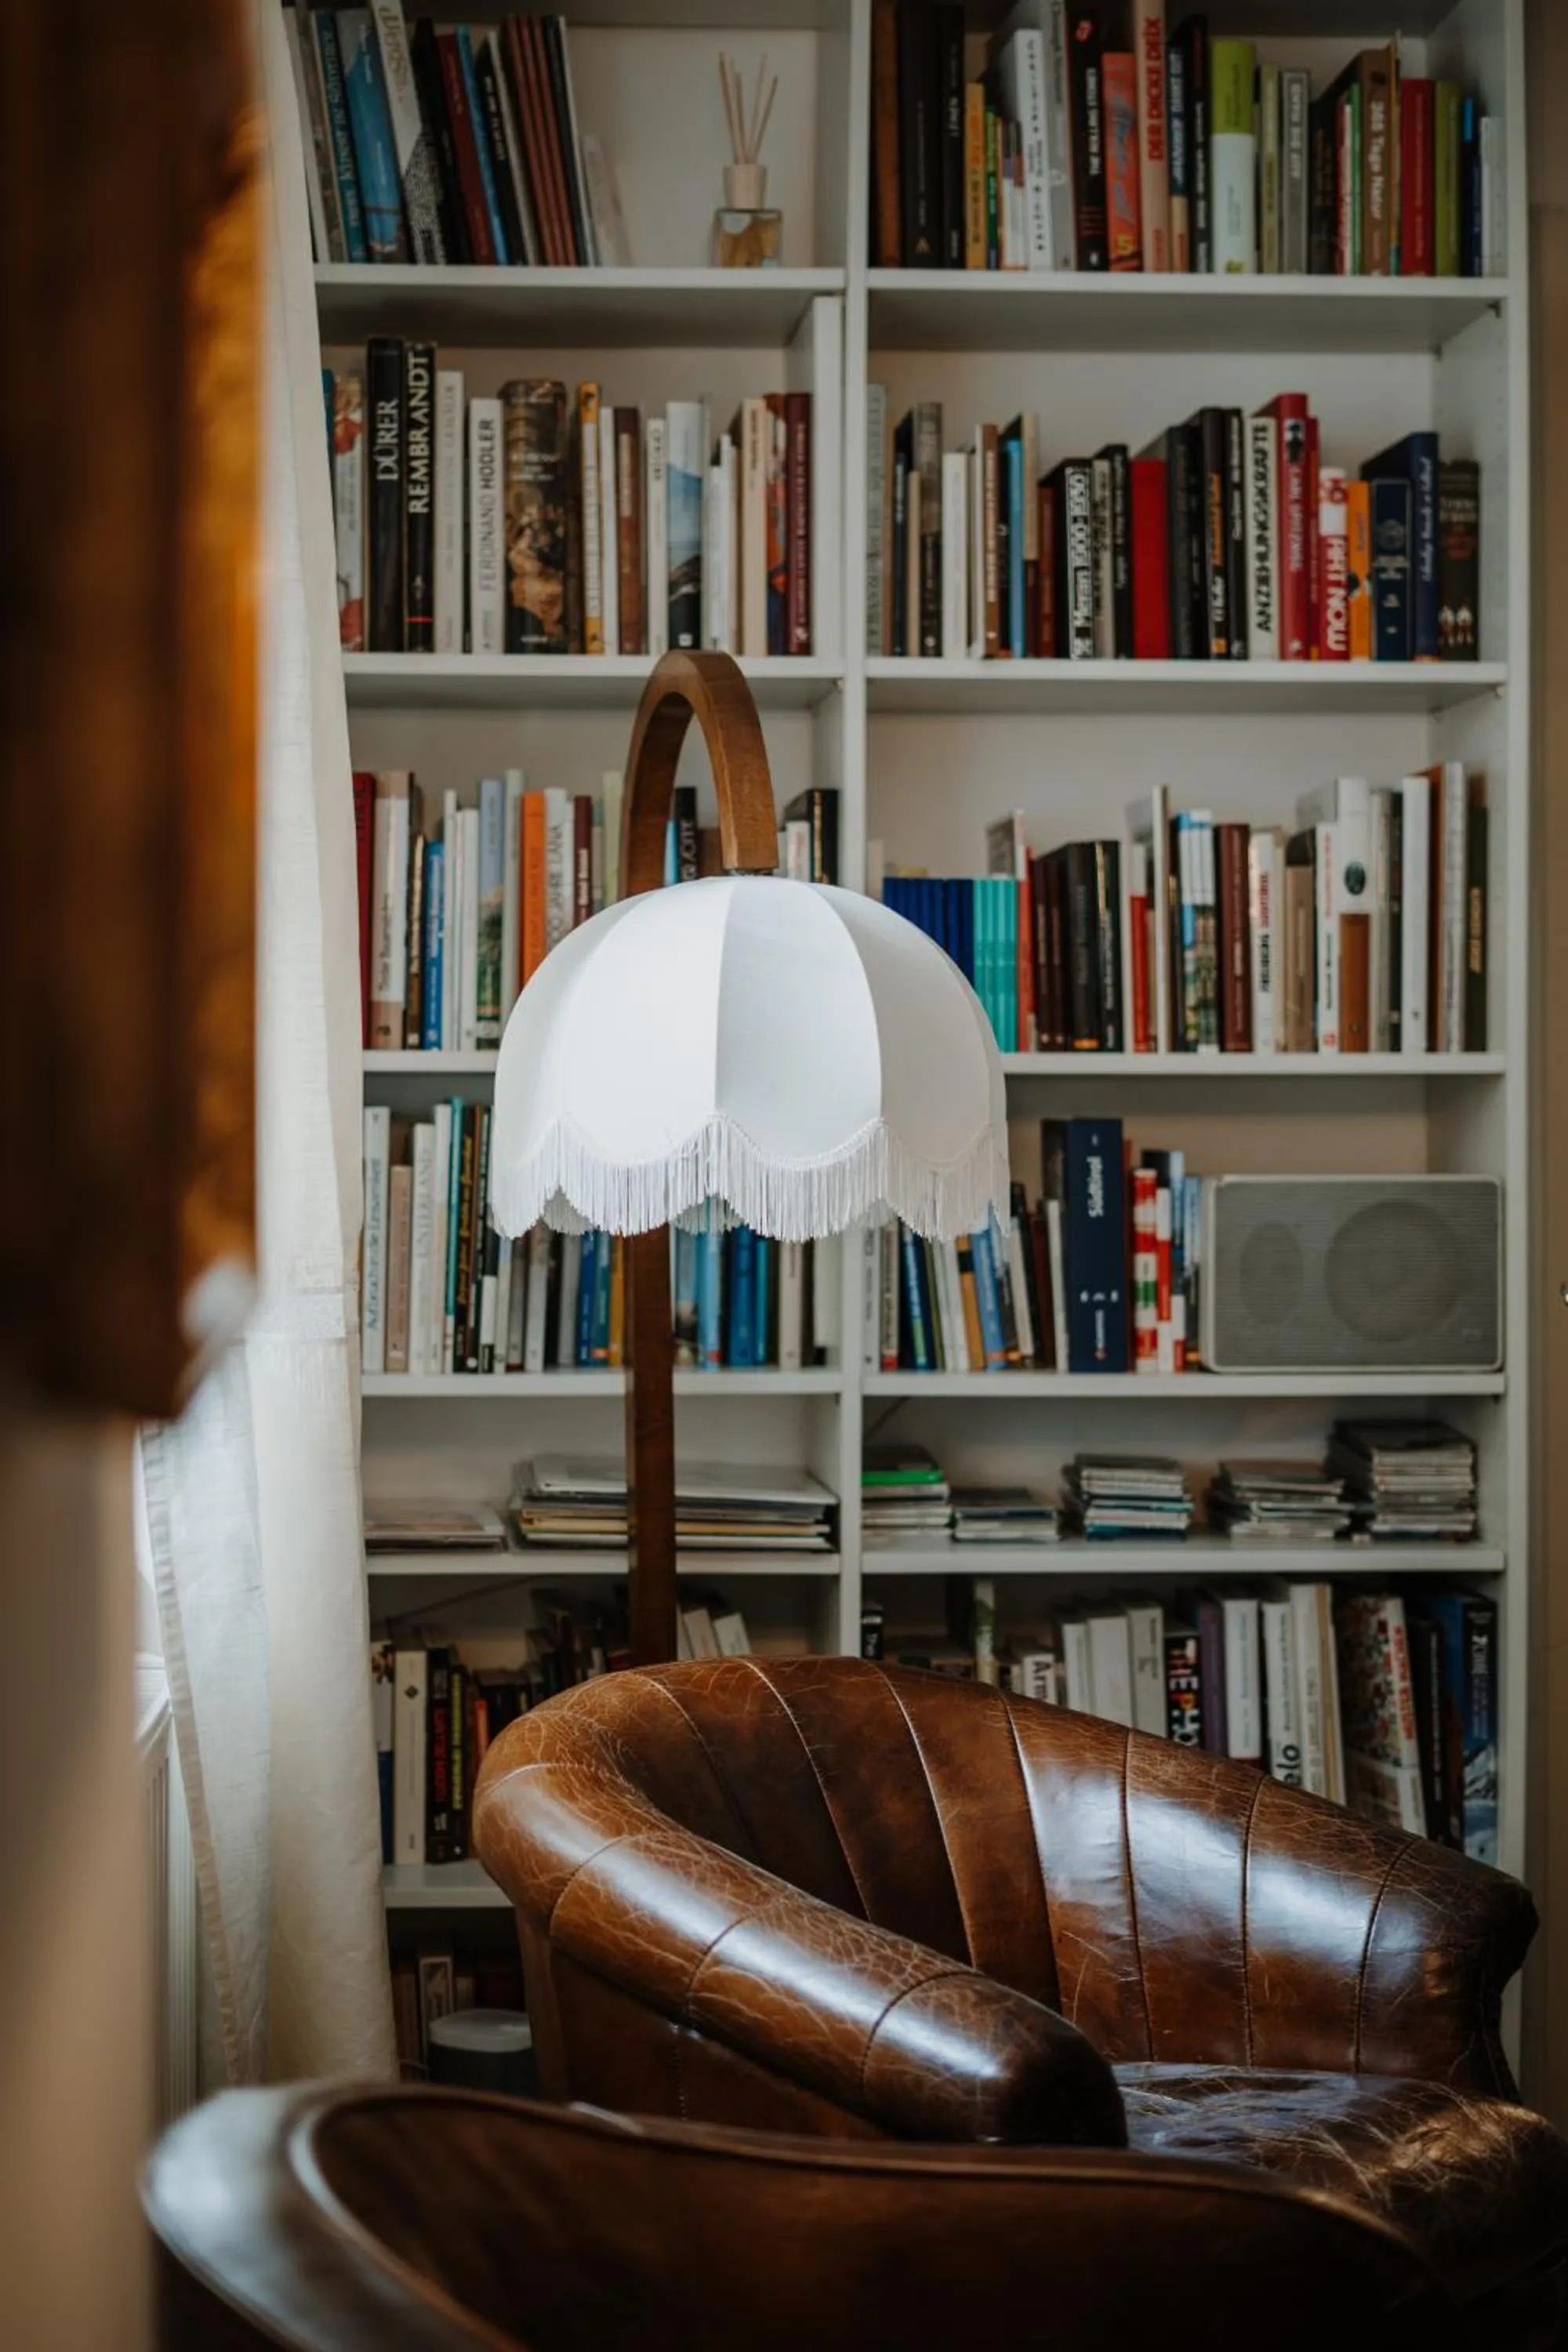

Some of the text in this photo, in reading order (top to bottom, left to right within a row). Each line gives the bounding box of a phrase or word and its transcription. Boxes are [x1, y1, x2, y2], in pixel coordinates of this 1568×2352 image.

[1369, 135, 1385, 173] Tage
[1370, 176, 1386, 221] Natur
[373, 399, 399, 481] DÜRER
[408, 354, 430, 514] REMBRANDT
[478, 418, 497, 593] FERDINAND HODLER
[1326, 588, 1347, 652] NOW
[546, 823, 563, 864] LANA
[1086, 1156, 1105, 1218] Südtirol
